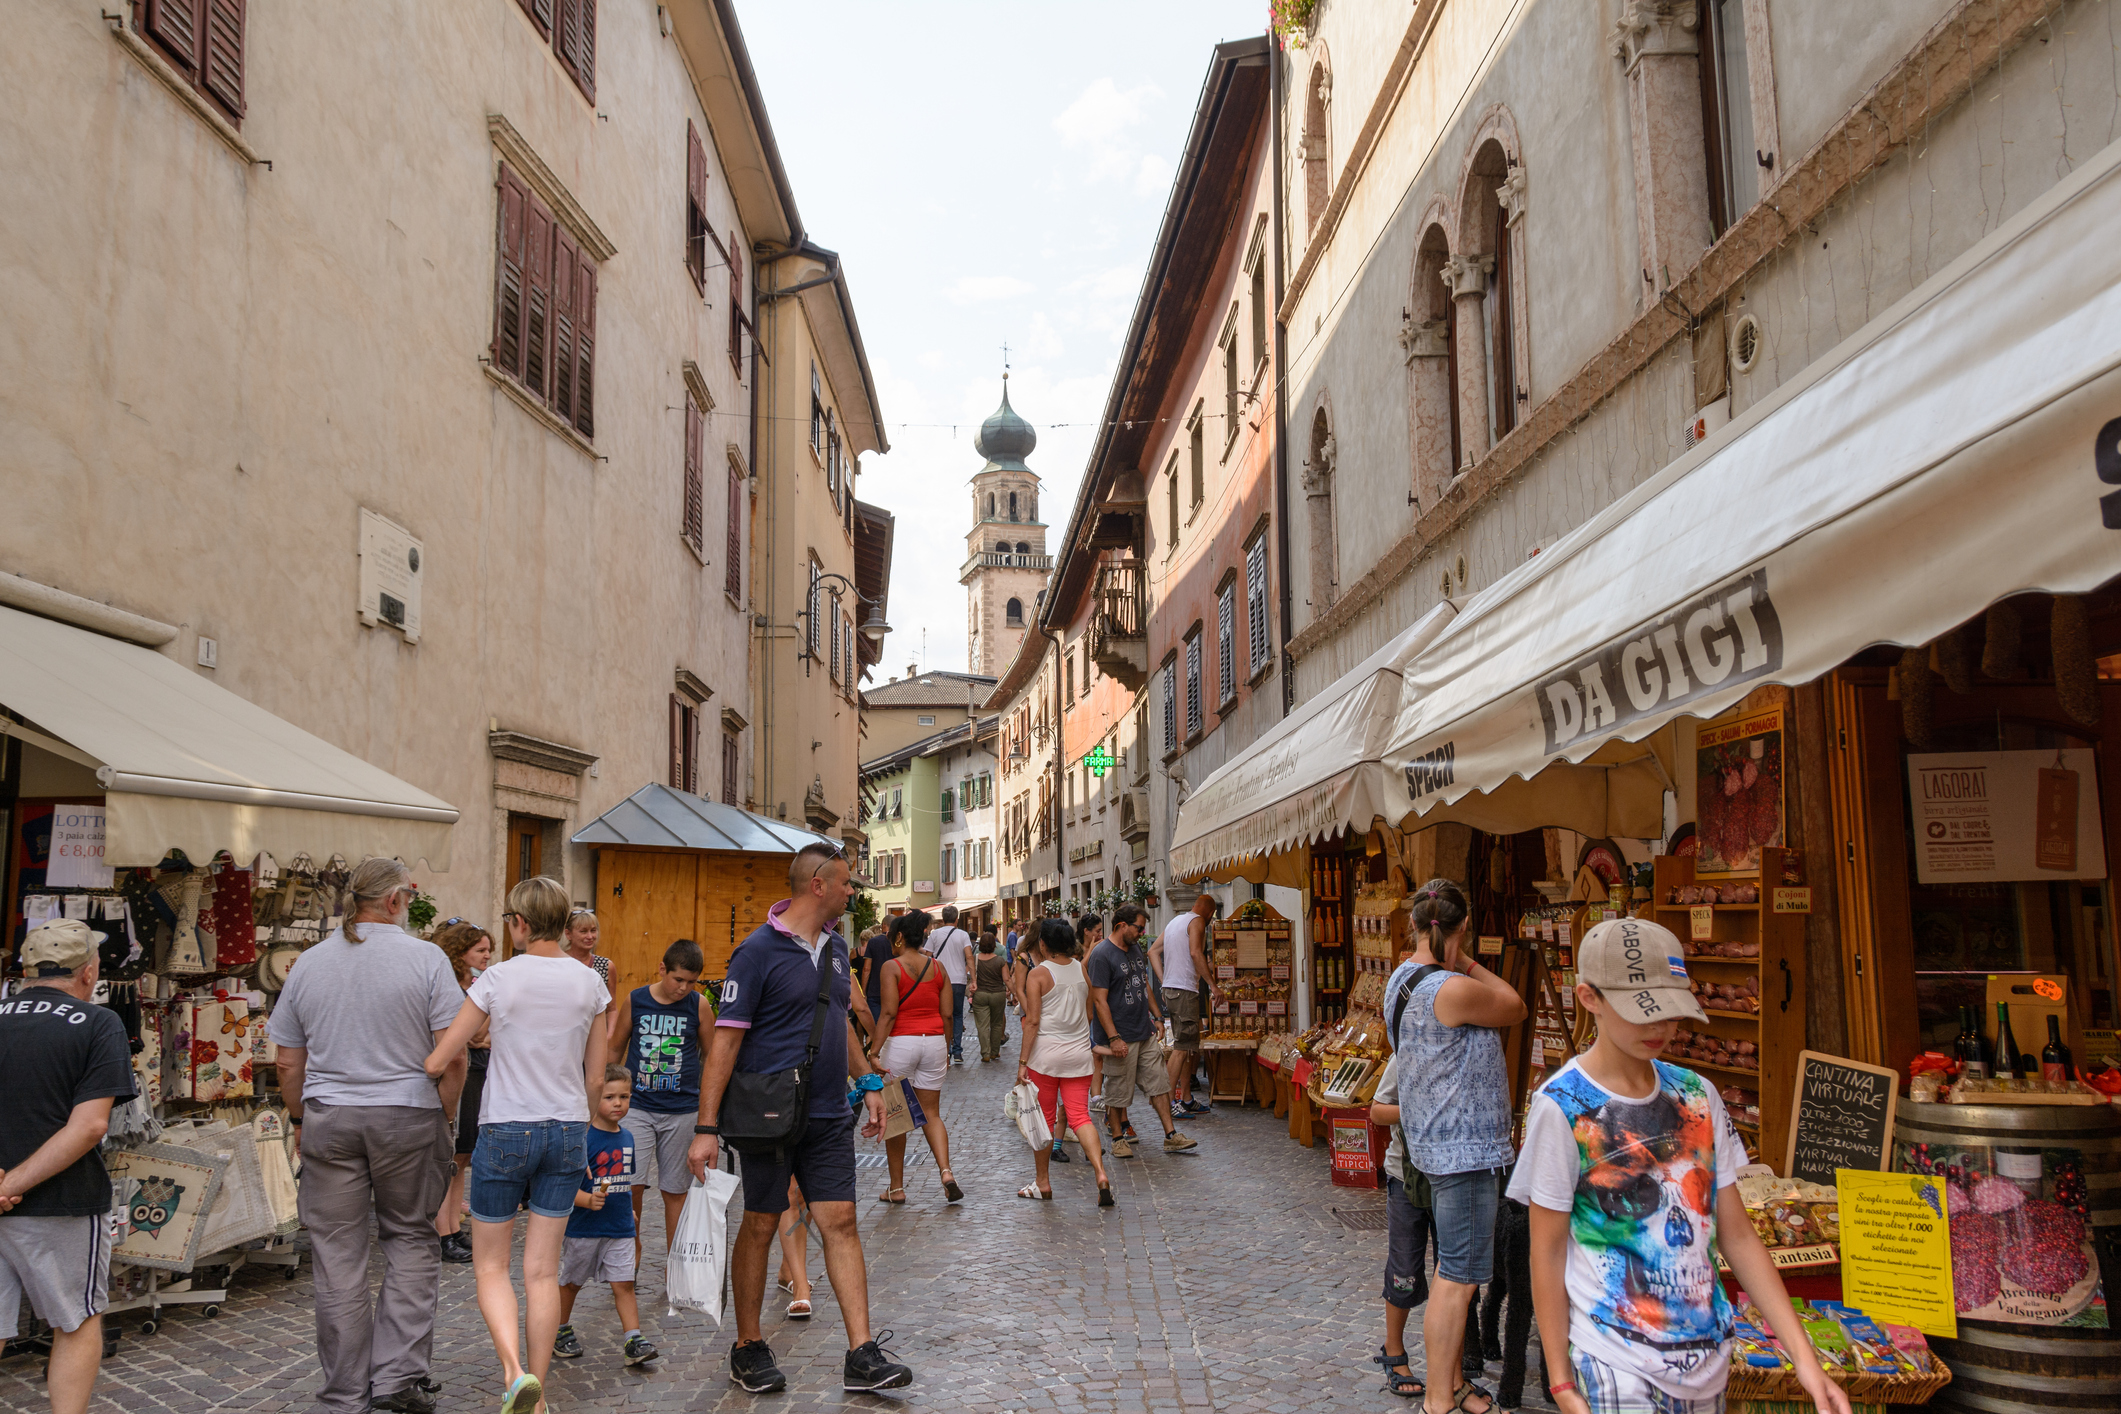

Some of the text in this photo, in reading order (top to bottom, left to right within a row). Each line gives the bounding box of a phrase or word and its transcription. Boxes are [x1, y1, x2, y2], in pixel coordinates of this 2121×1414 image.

[1546, 586, 1767, 744] DA GIGI
[1701, 716, 1778, 746] SPECK SALUMI FORMAGGI
[1084, 756, 1114, 766] FARMA
[1405, 741, 1455, 800] SPECK
[1922, 772, 1986, 799] LAGORAI
[1313, 782, 1338, 827] GIGI
[58, 832, 106, 841] 3 paia calz
[73, 845, 105, 858] 8,00
[1778, 890, 1807, 899] Cojoni
[1692, 910, 1711, 919] SPECK
[1695, 925, 1709, 934] Cuore
[1632, 990, 1662, 1017] RDE
[638, 1014, 687, 1036] SURF
[639, 1034, 685, 1074] 95
[635, 1072, 682, 1093] DUDE
[1805, 1062, 1875, 1093] CANTINA
[1808, 1081, 1884, 1110] VIRTUALE
[1800, 1107, 1864, 1128] OLTRE 1000
[1798, 1121, 1870, 1139] ETICHETTE
[1345, 1134, 1366, 1149] Gigi
[1800, 1131, 1879, 1157] SELEZIONATE
[1338, 1160, 1368, 1169] TIPICI
[1856, 1192, 1884, 1206] Scegli
[1892, 1197, 1928, 1209] catalogo
[1855, 1204, 1931, 1220] la nostra proposta
[1854, 1218, 1933, 1232] vini tra oltre 1.000
[1863, 1230, 1926, 1244] etichette da noi
[1769, 1248, 1832, 1264] Fantasia
[1871, 1243, 1918, 1256] selezionate
[1997, 1300, 2069, 1320] Valsugana
